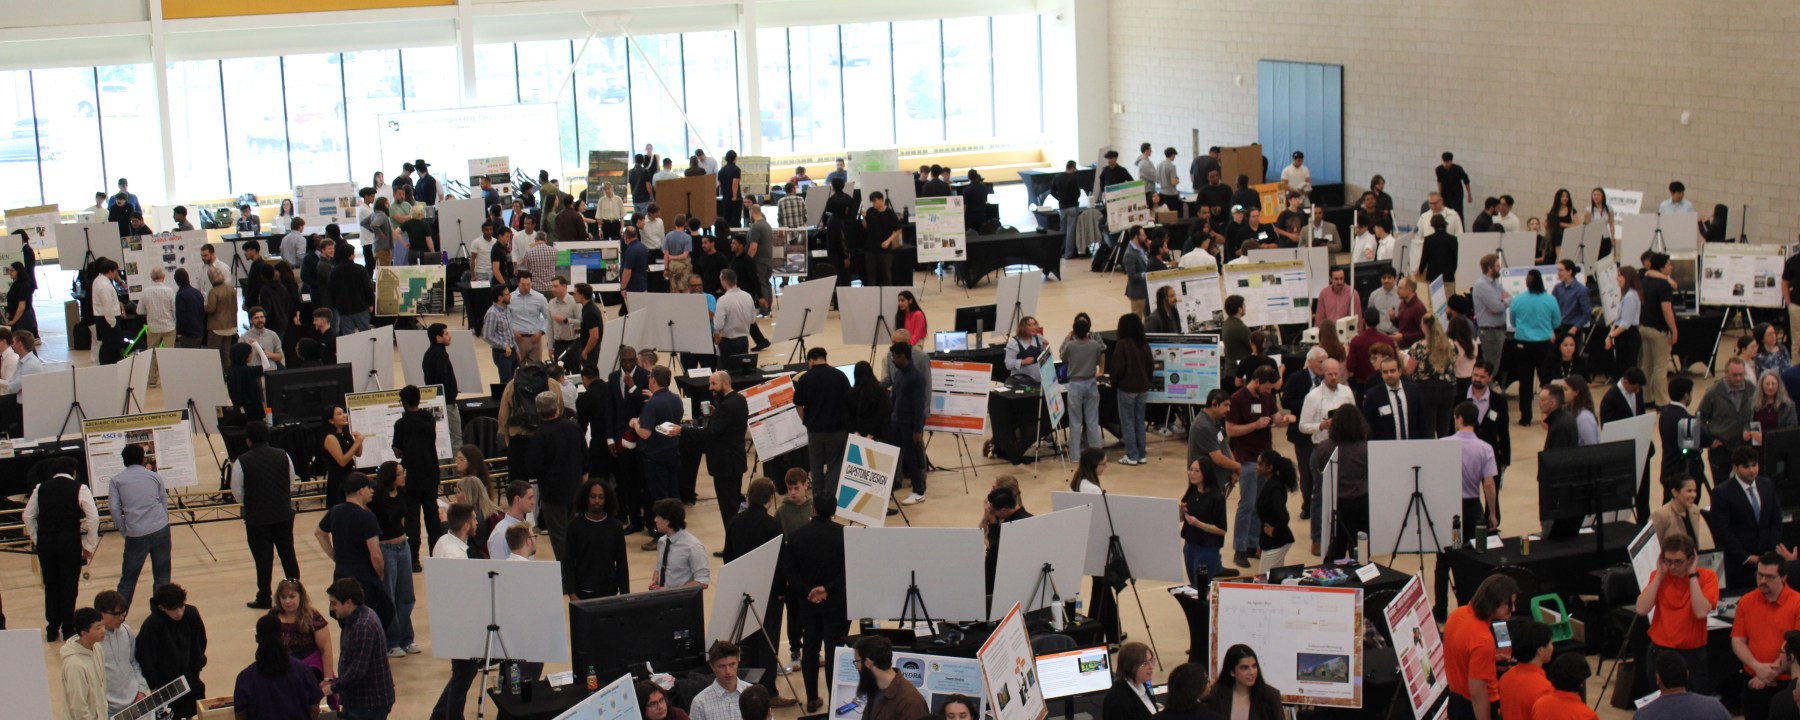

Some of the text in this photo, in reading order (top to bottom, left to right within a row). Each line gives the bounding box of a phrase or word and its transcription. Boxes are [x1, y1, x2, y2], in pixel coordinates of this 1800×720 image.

[145, 413, 177, 421] COMPETITION
[846, 465, 888, 485] CAPSTONE DESIGN
